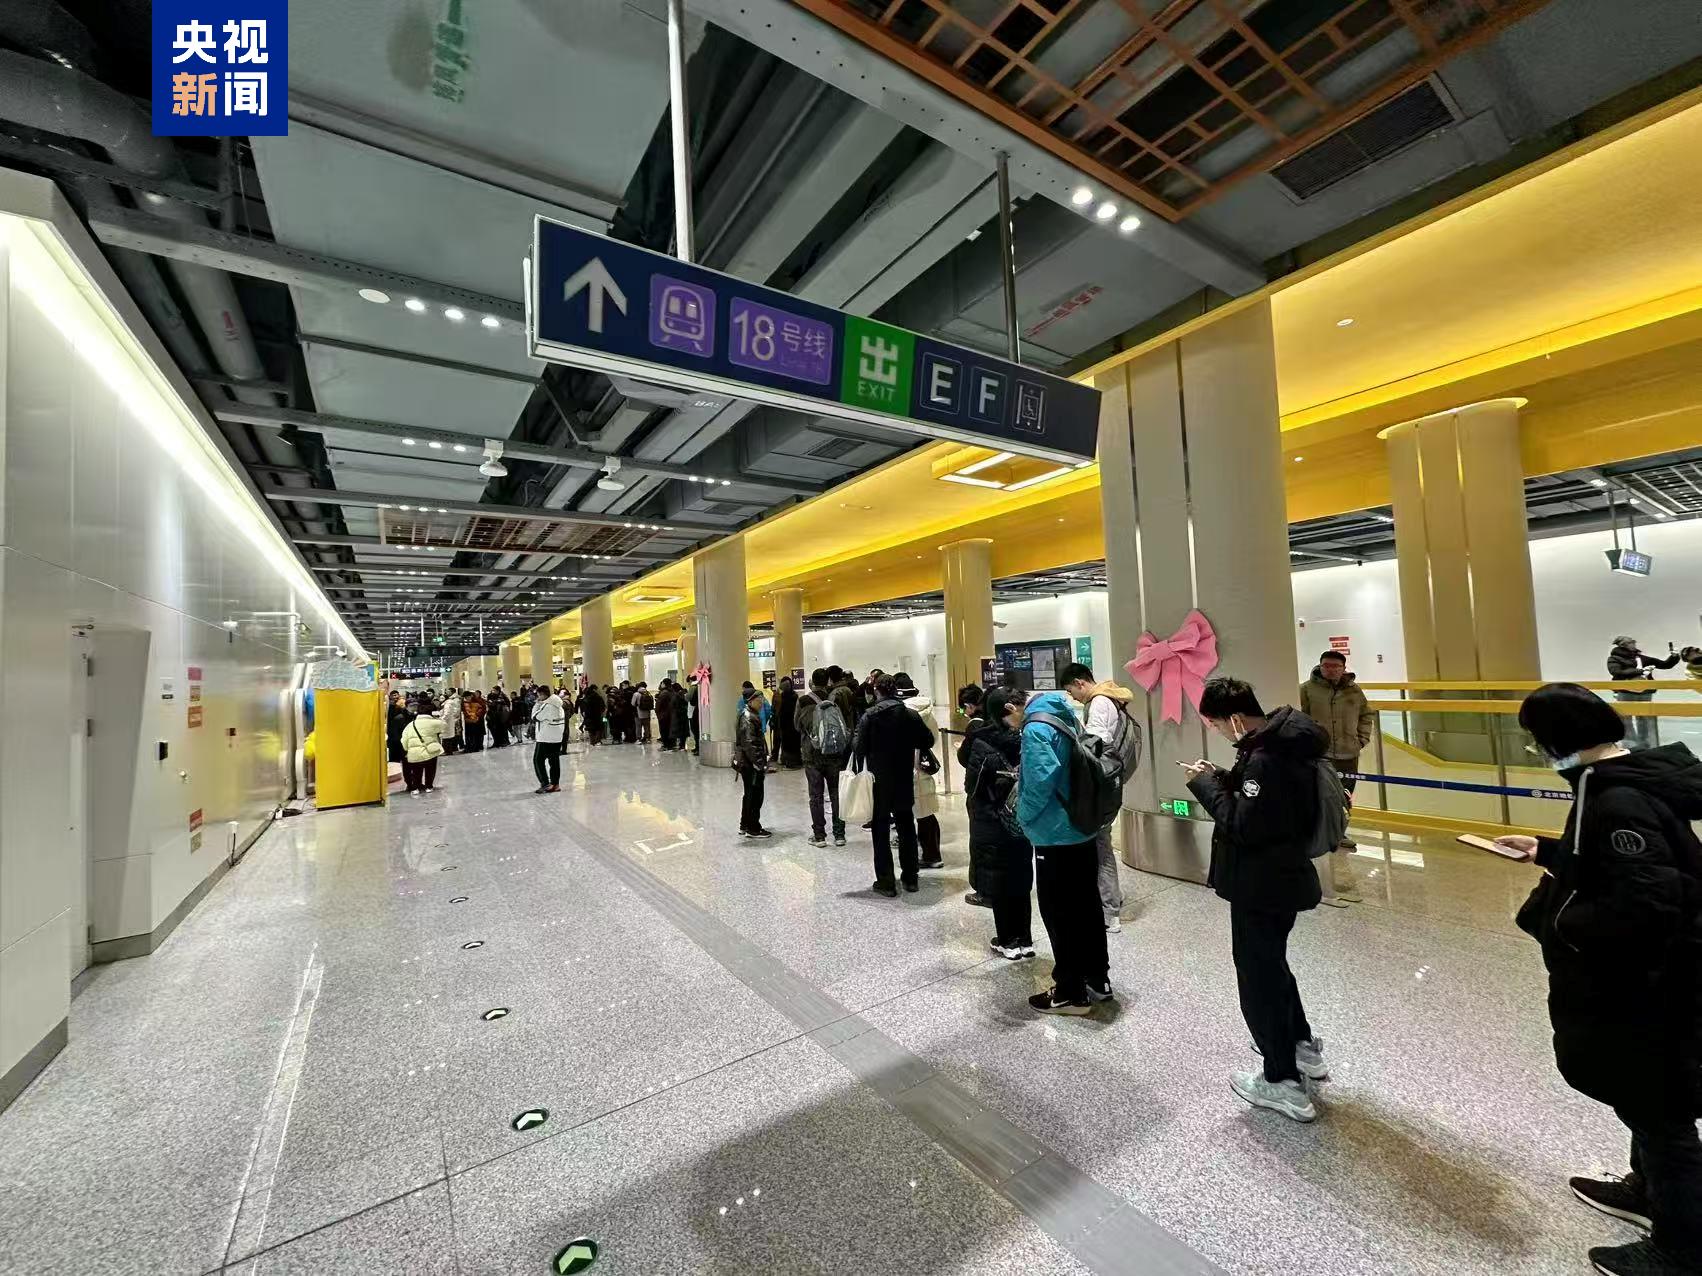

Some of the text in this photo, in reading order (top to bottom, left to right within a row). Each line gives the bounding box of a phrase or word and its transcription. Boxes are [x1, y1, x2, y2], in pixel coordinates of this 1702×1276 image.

[859, 336, 898, 385] 出
[857, 381, 897, 401] EXIT
[930, 363, 999, 414] E F
